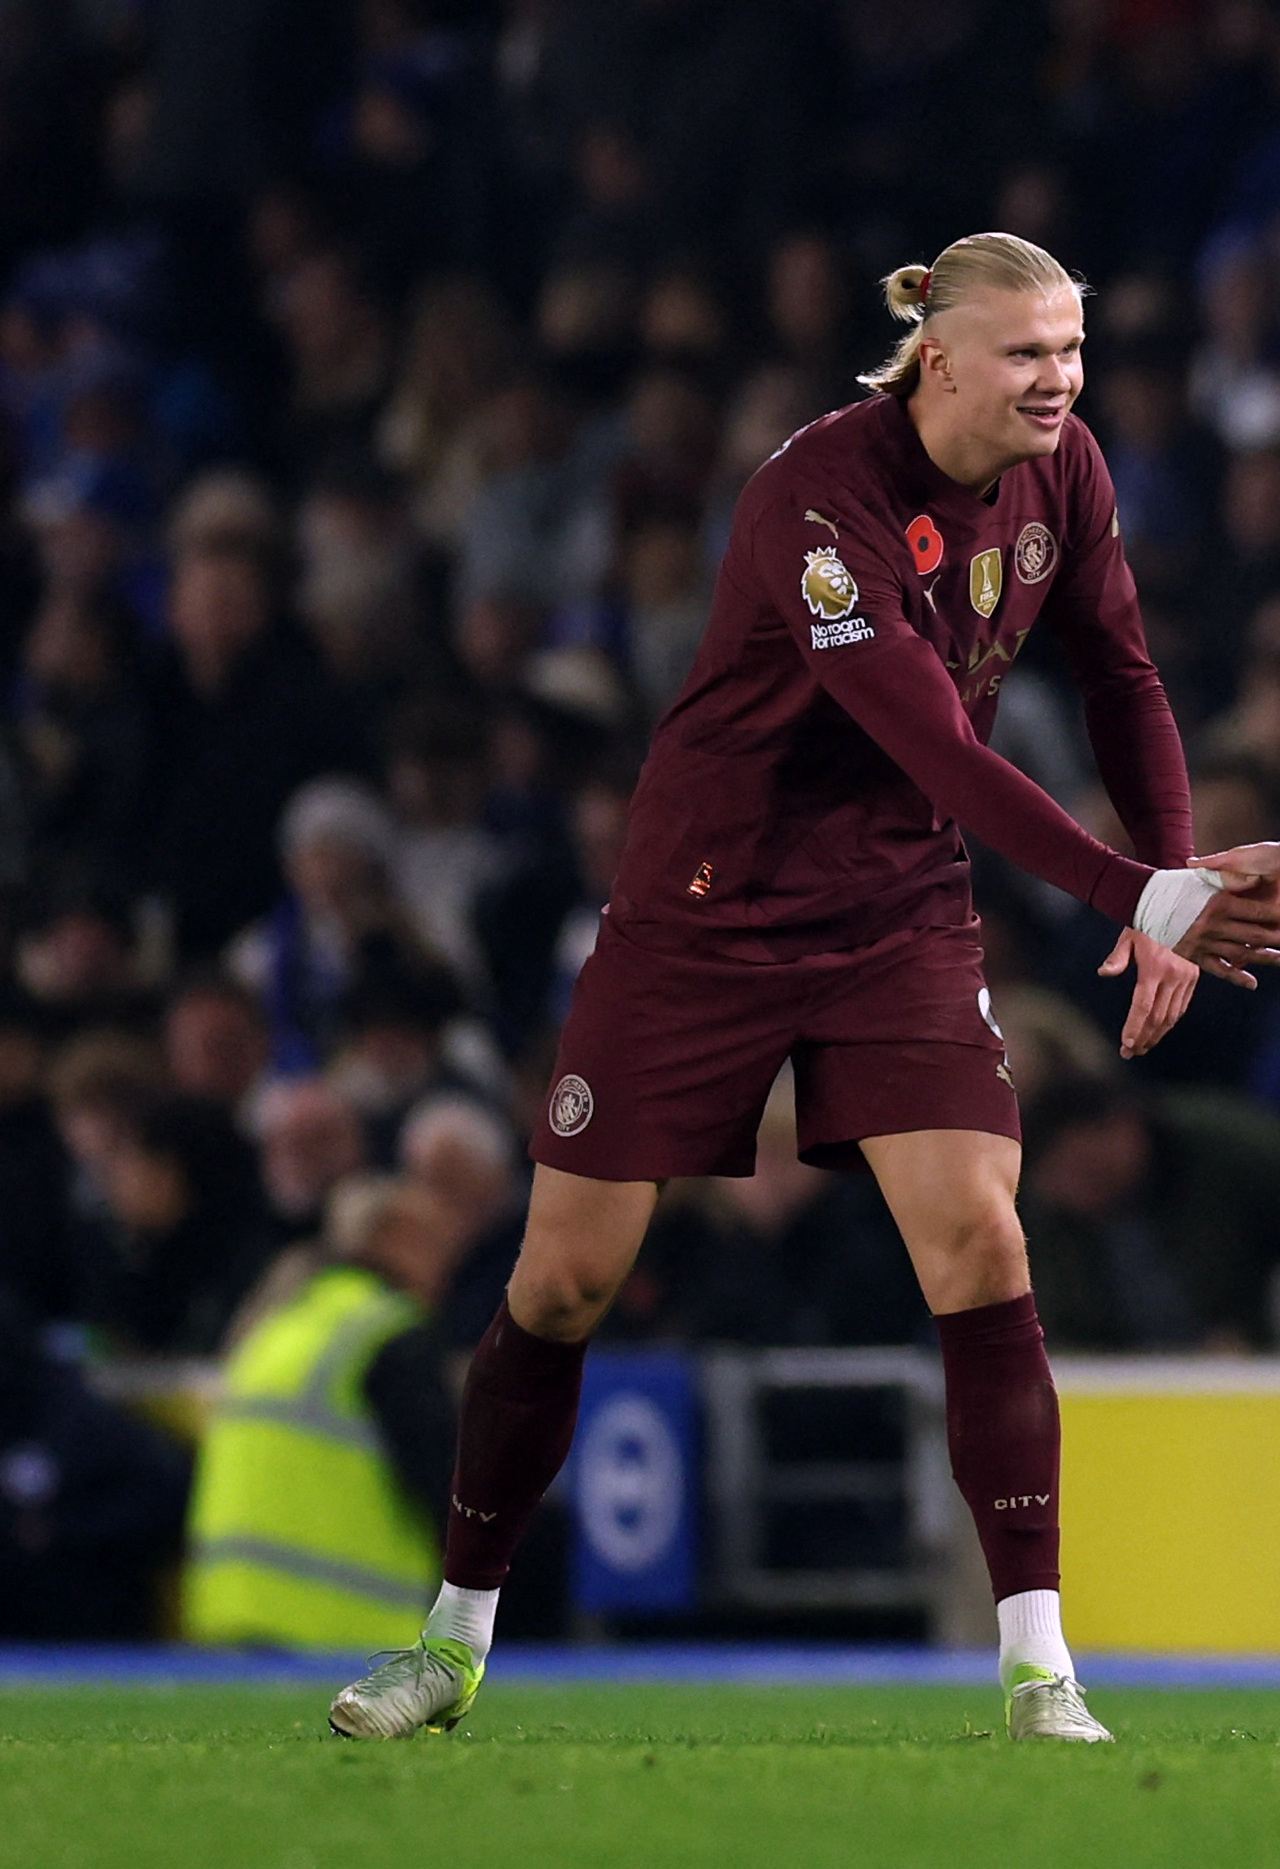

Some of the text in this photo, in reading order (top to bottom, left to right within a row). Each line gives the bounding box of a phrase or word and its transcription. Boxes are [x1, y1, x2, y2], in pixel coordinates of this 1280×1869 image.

[810, 617, 866, 638] No room
[830, 627, 875, 647] racism
[994, 1494, 1050, 1510] CITY
